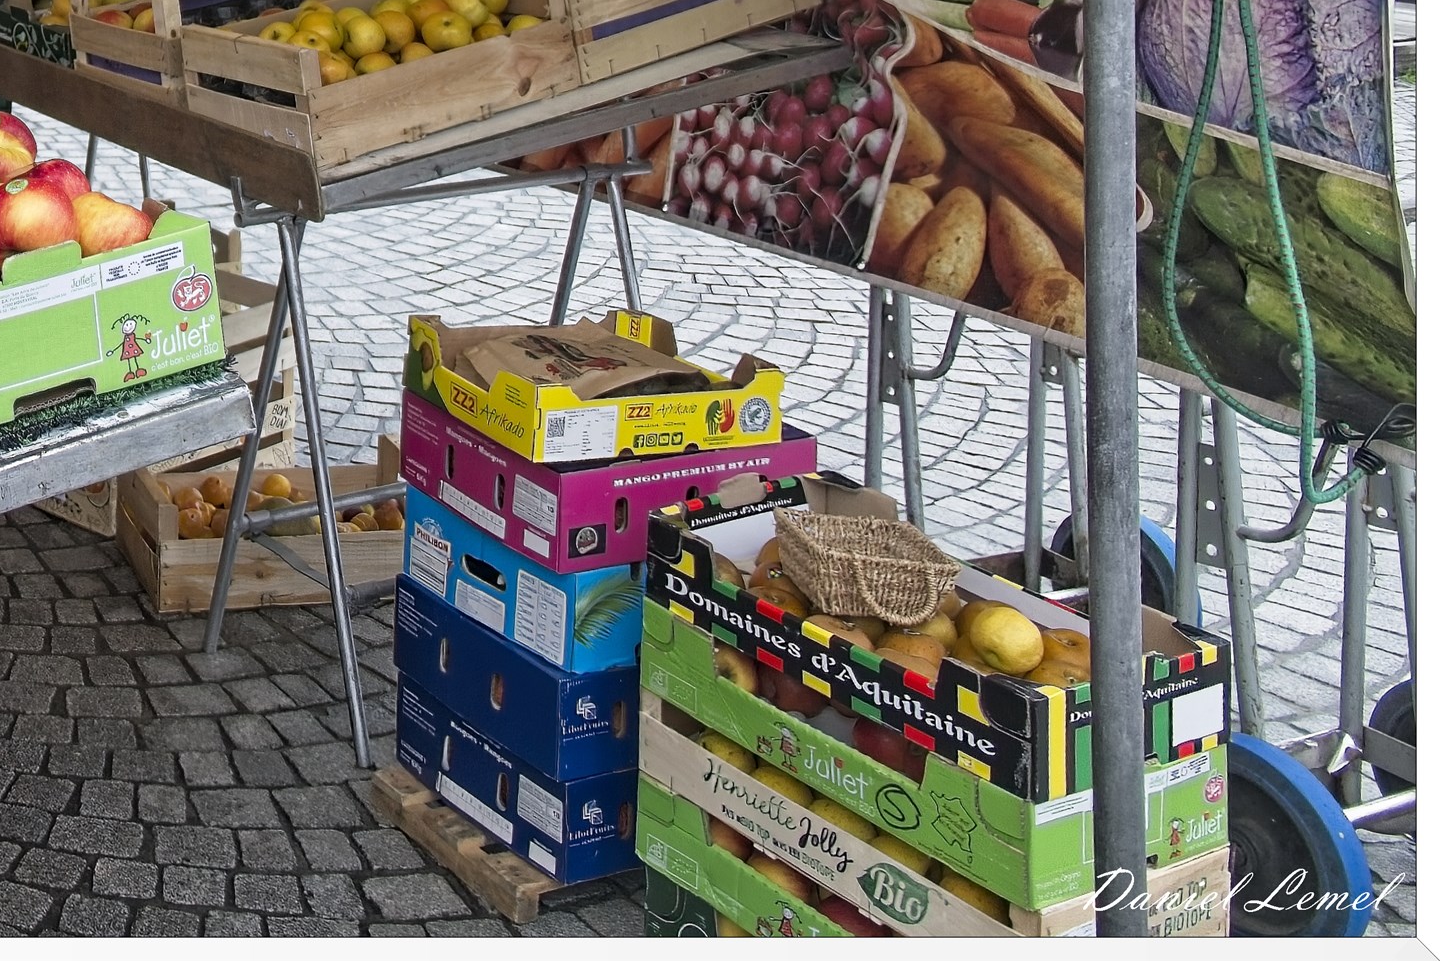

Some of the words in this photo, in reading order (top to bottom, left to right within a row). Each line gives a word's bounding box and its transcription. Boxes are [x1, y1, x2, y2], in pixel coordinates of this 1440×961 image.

[151, 317, 210, 359] Juliet
[152, 361, 168, 371] c'est
[185, 349, 202, 362] c'est
[204, 342, 219, 355] BIO
[452, 386, 475, 413] ZZ2
[480, 403, 525, 438] Afrikado
[627, 405, 651, 418] ZZ2
[655, 402, 698, 418] Afrikado
[613, 473, 660, 487] MANGO
[662, 464, 726, 480] PREMIUM
[728, 461, 745, 470] BY
[746, 458, 770, 467] AIR
[691, 511, 738, 527] Domaines
[416, 527, 448, 553] PHILIBON
[664, 573, 801, 659] Domaines
[811, 652, 996, 756] d'Aquitaine
[804, 743, 868, 800] Juliet
[703, 758, 797, 831] Henriette
[798, 816, 854, 873] Jolly
[1186, 809, 1223, 842] Juliet
[870, 867, 922, 921] Bio
